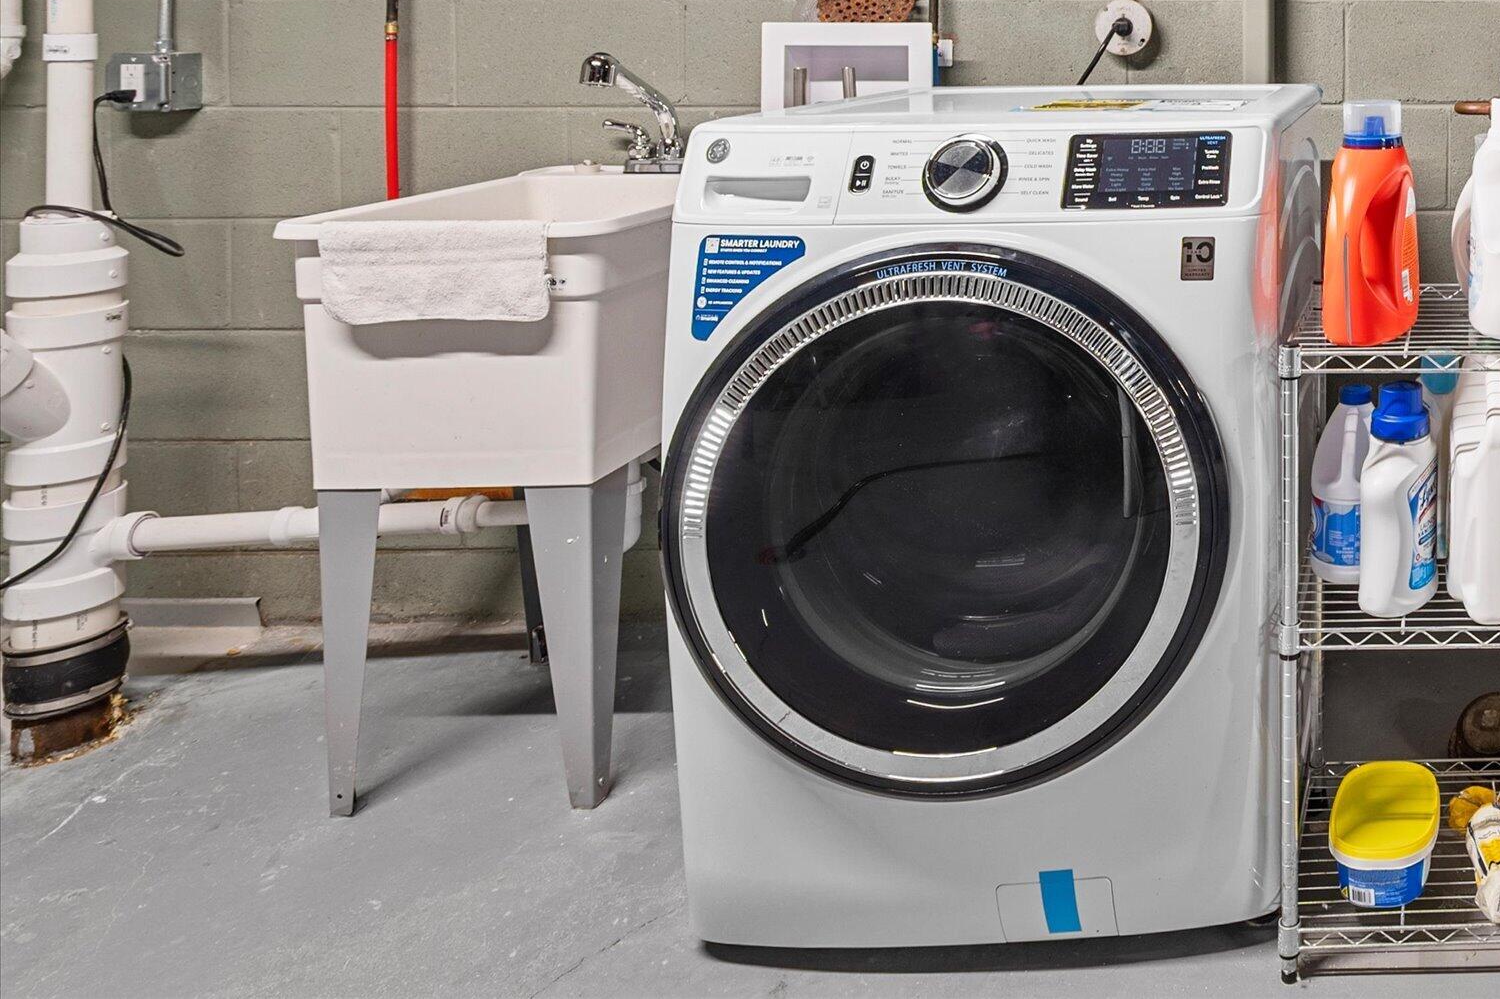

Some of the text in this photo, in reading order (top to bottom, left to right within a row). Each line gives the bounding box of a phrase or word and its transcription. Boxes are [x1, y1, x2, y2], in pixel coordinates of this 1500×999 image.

[721, 239, 800, 249] SMARTER LAUNDRY
[1183, 241, 1214, 263] 10
[876, 261, 1008, 279] ULTRAFRESH VENT SYSTEM
